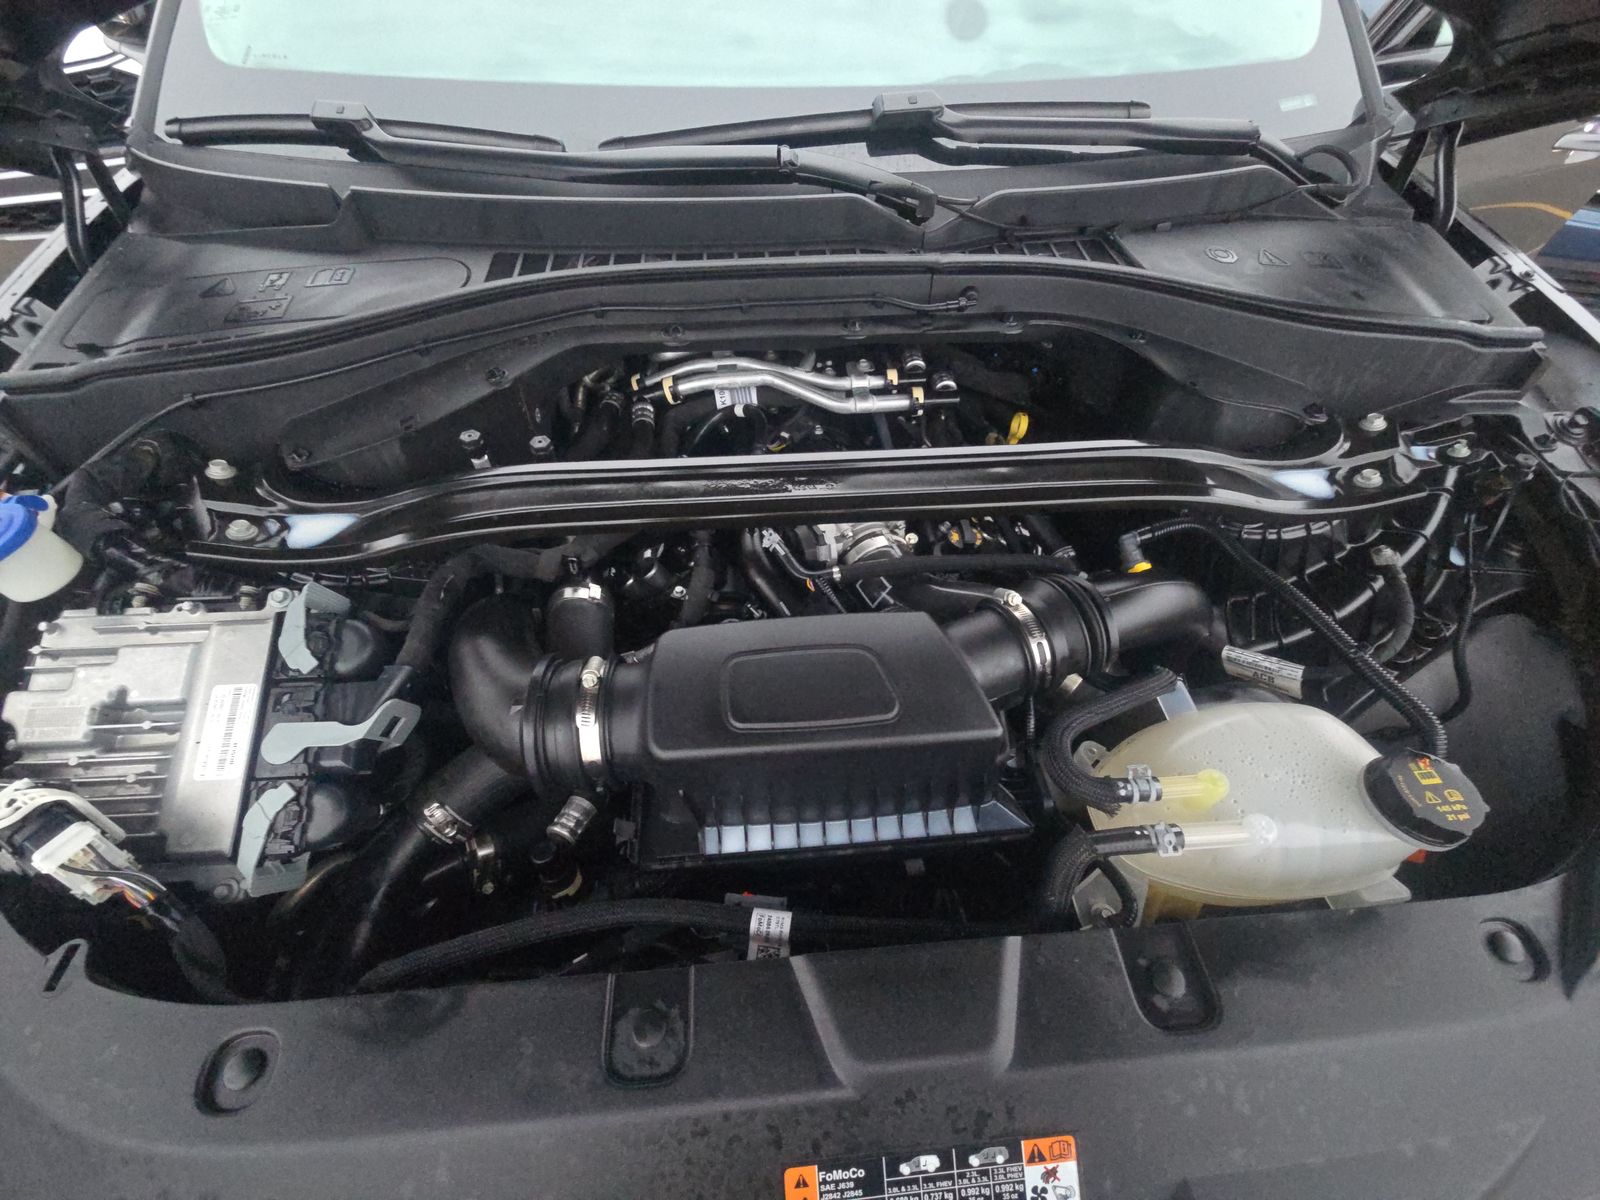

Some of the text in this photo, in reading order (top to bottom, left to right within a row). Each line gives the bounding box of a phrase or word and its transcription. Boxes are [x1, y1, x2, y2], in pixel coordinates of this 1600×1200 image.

[819, 1167, 865, 1182] FoMoCo
[820, 1181, 855, 1191] SAE J639
[980, 1186, 990, 1196] kg
[1014, 1182, 1024, 1192] kg
[842, 1189, 863, 1198] J2845
